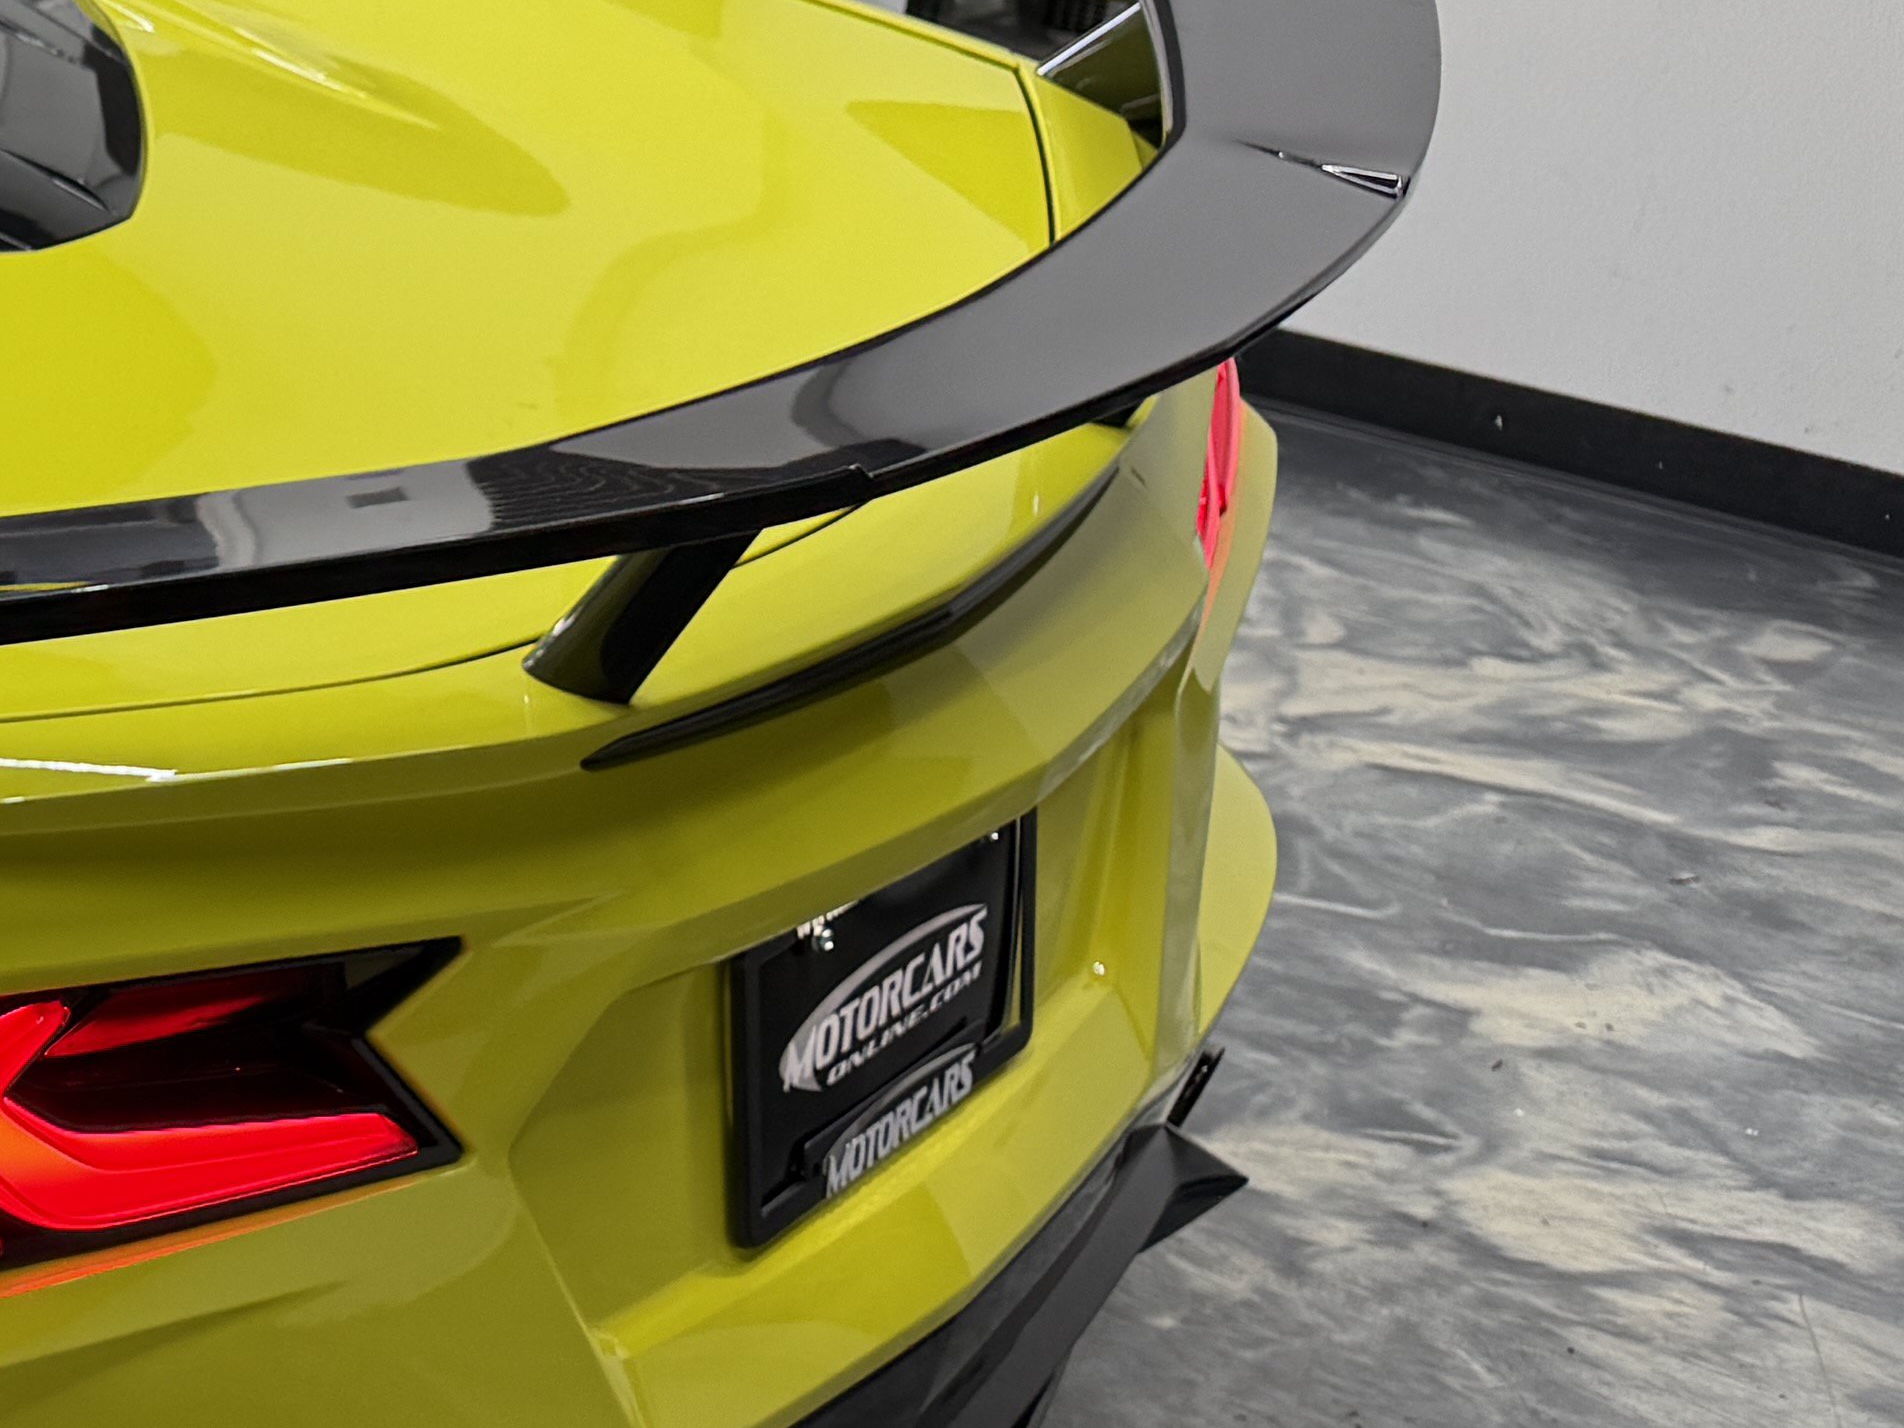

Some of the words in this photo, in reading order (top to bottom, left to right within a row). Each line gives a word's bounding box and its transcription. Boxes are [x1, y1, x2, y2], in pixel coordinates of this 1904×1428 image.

[783, 906, 988, 1093] MOTORCARS
[826, 960, 983, 1086] ONLINE.COM
[825, 1049, 977, 1200] MOTORCARS
